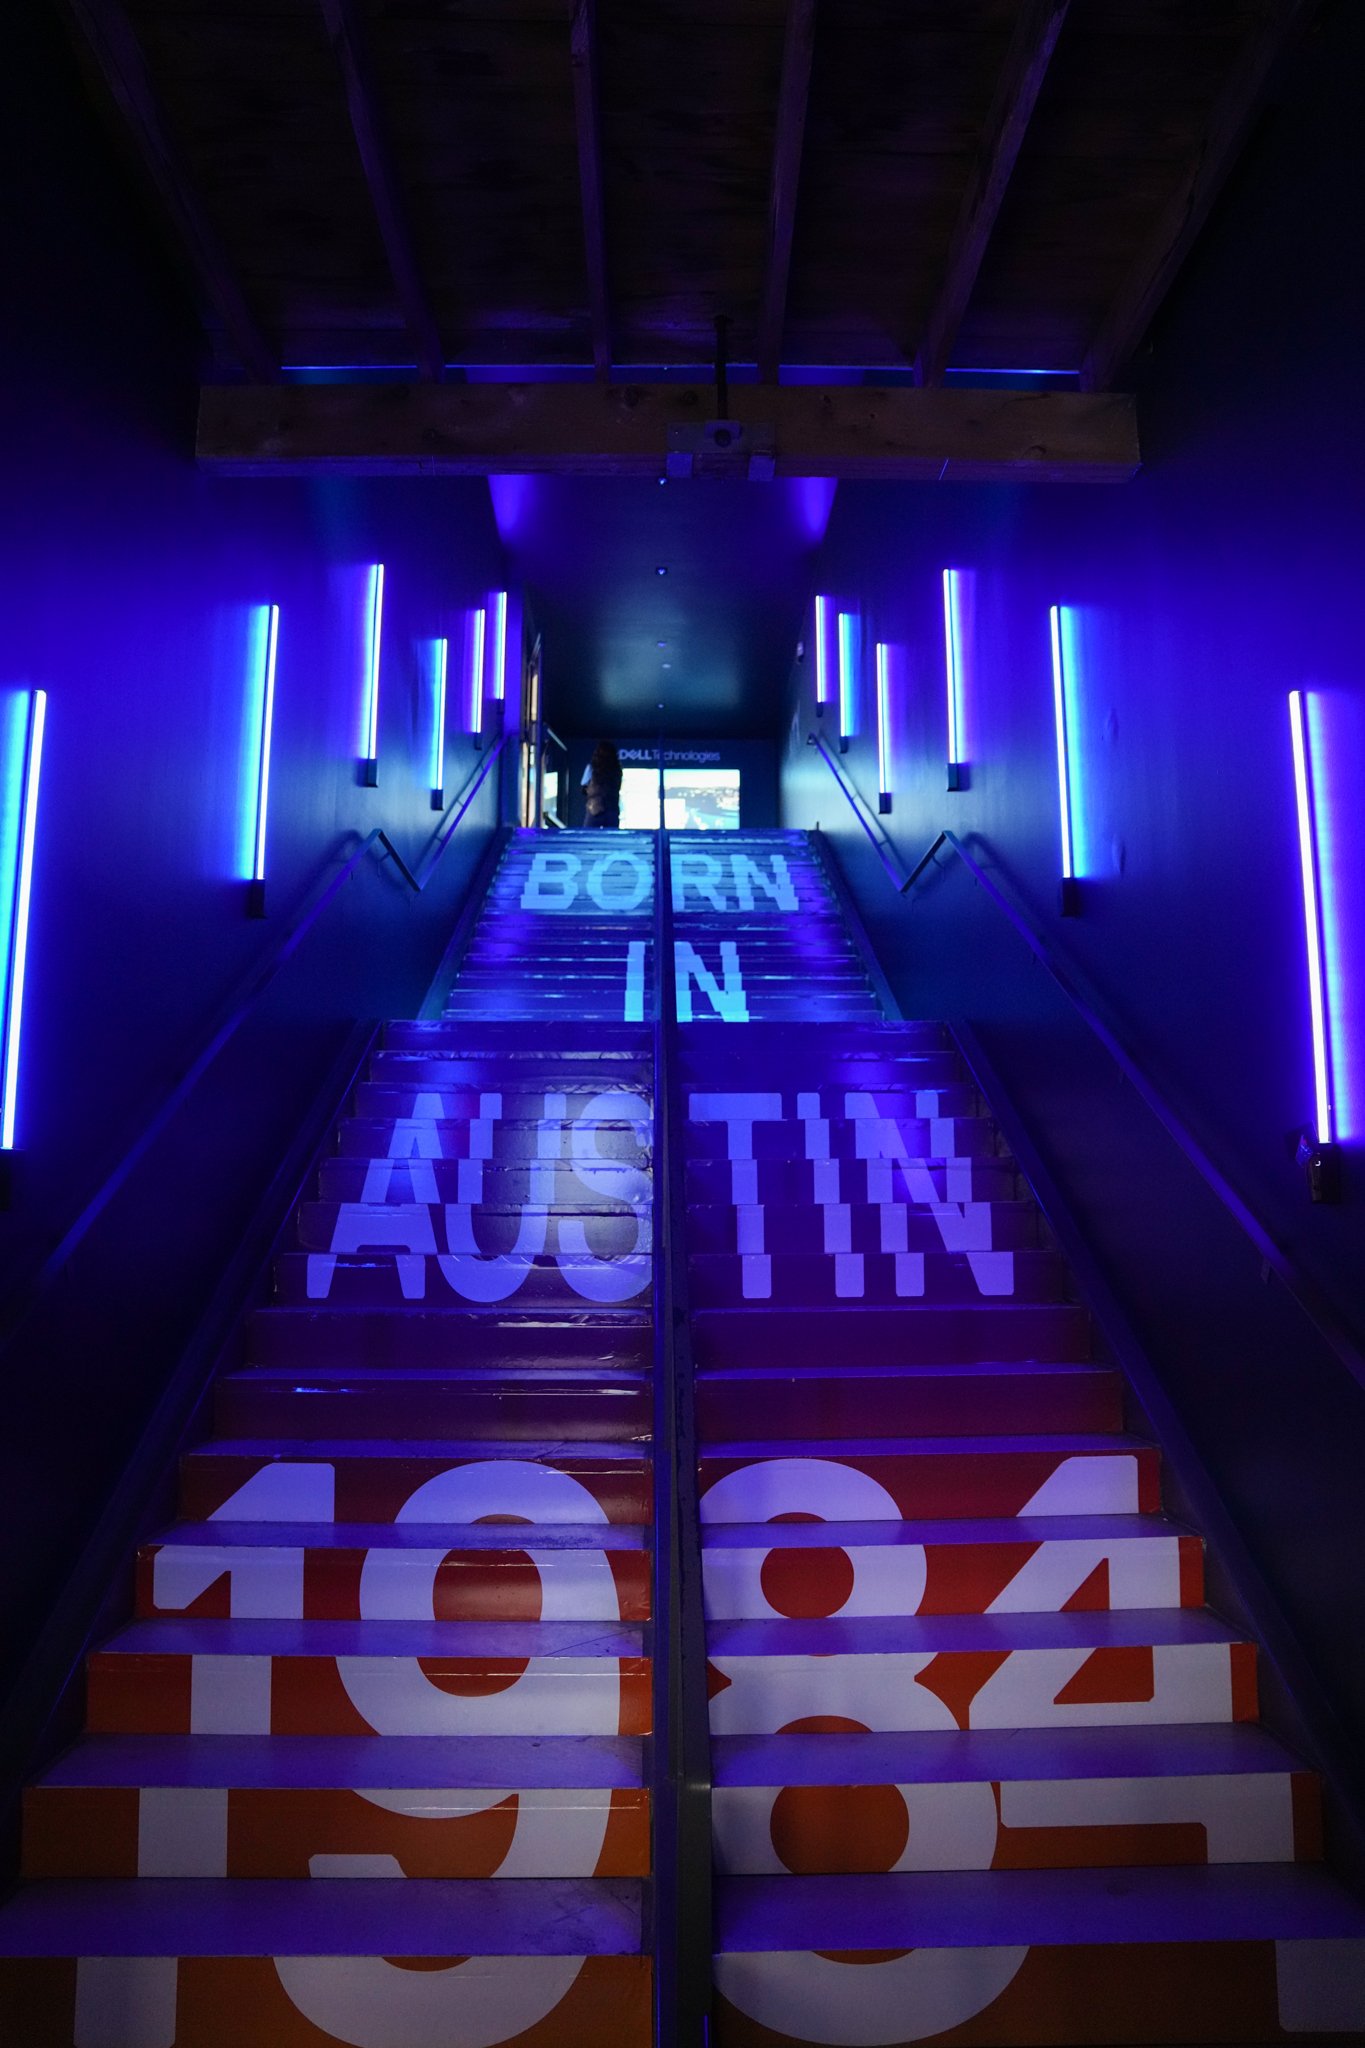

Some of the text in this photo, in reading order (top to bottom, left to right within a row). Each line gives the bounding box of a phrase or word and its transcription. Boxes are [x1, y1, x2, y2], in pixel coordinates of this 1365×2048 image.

[618, 749, 652, 760] DELL
[520, 852, 799, 911] BORN
[624, 941, 750, 1023] IN
[307, 1092, 1015, 1302] AUSTIN
[72, 1456, 1365, 2048] 1984
